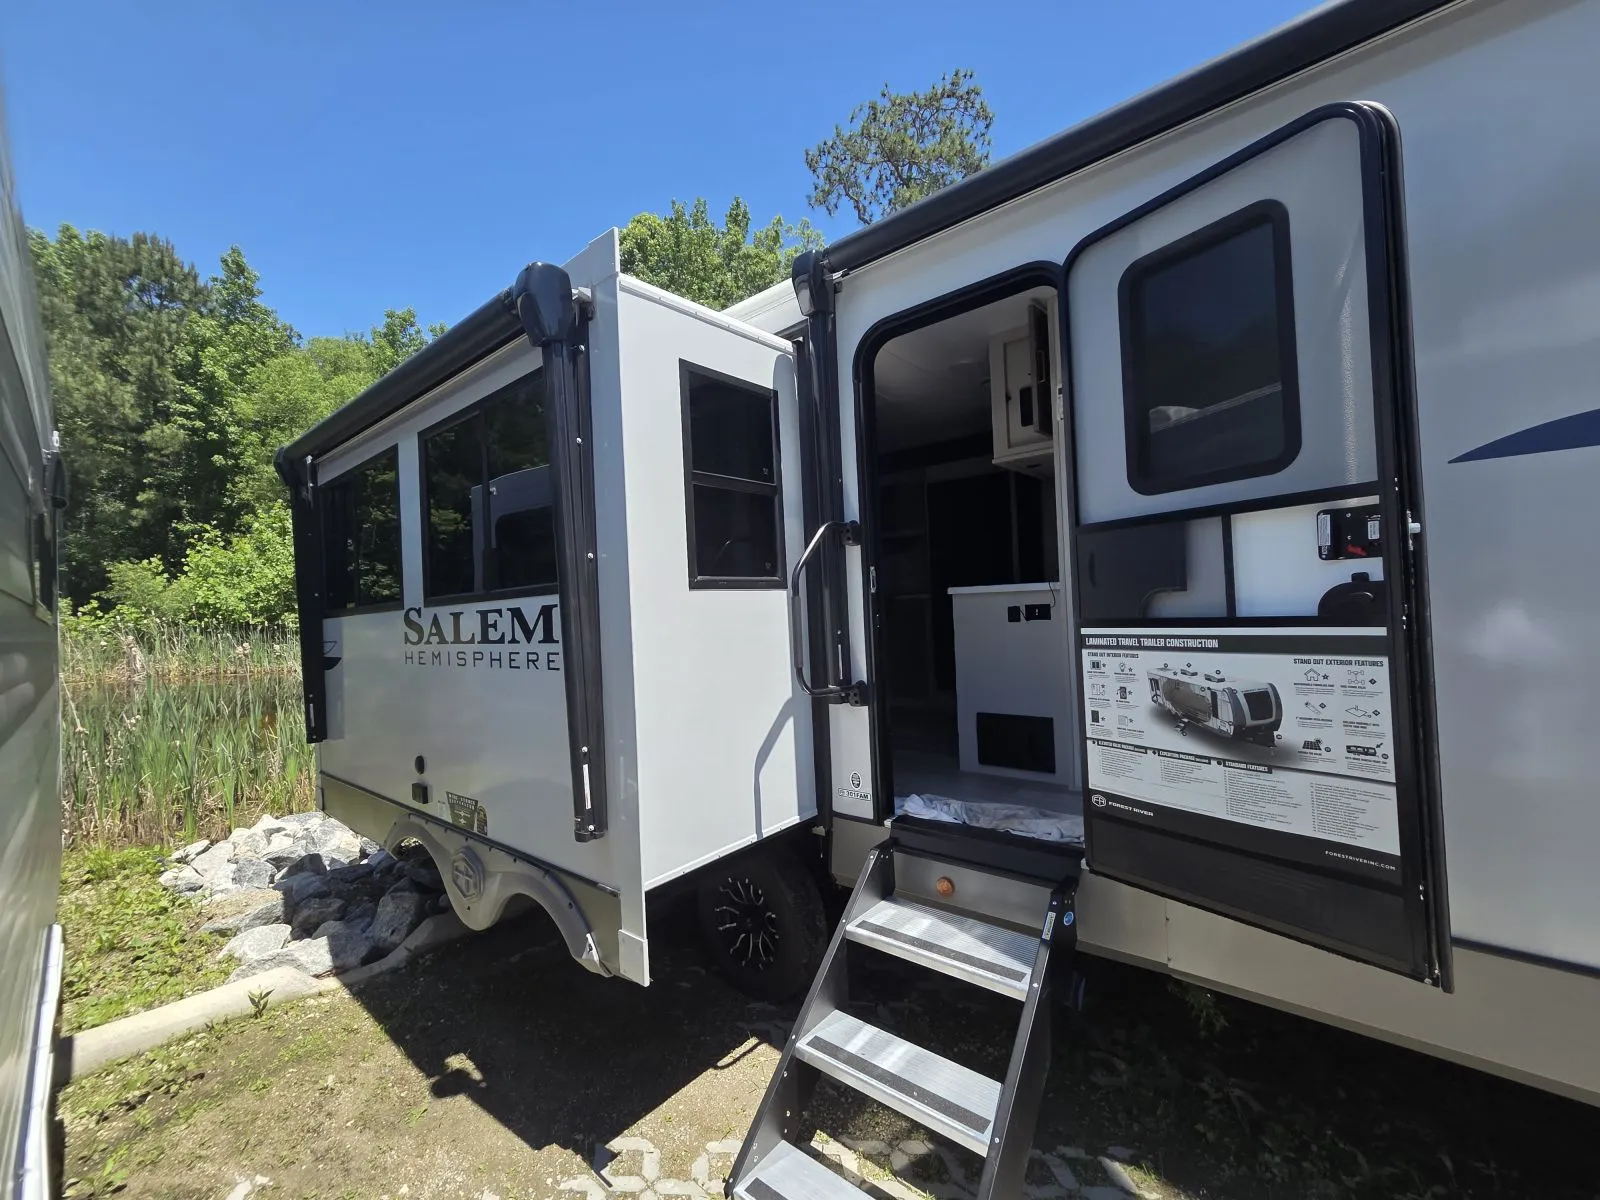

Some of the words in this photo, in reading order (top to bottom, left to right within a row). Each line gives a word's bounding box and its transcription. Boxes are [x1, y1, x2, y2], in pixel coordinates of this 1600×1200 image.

[403, 604, 560, 646] SALEM
[1085, 637, 1117, 646] LAMINATED
[1118, 638, 1140, 647] TRAVEL
[1140, 638, 1165, 648] TRAILER
[1166, 638, 1219, 648] CONSTRUCTION
[404, 650, 561, 671] HEMISPHERE
[1354, 659, 1384, 667] FEATURES
[1108, 801, 1133, 811] FOREST
[1132, 807, 1154, 817] RIVER
[1325, 850, 1396, 871] FORESTRIVERINC.COM
